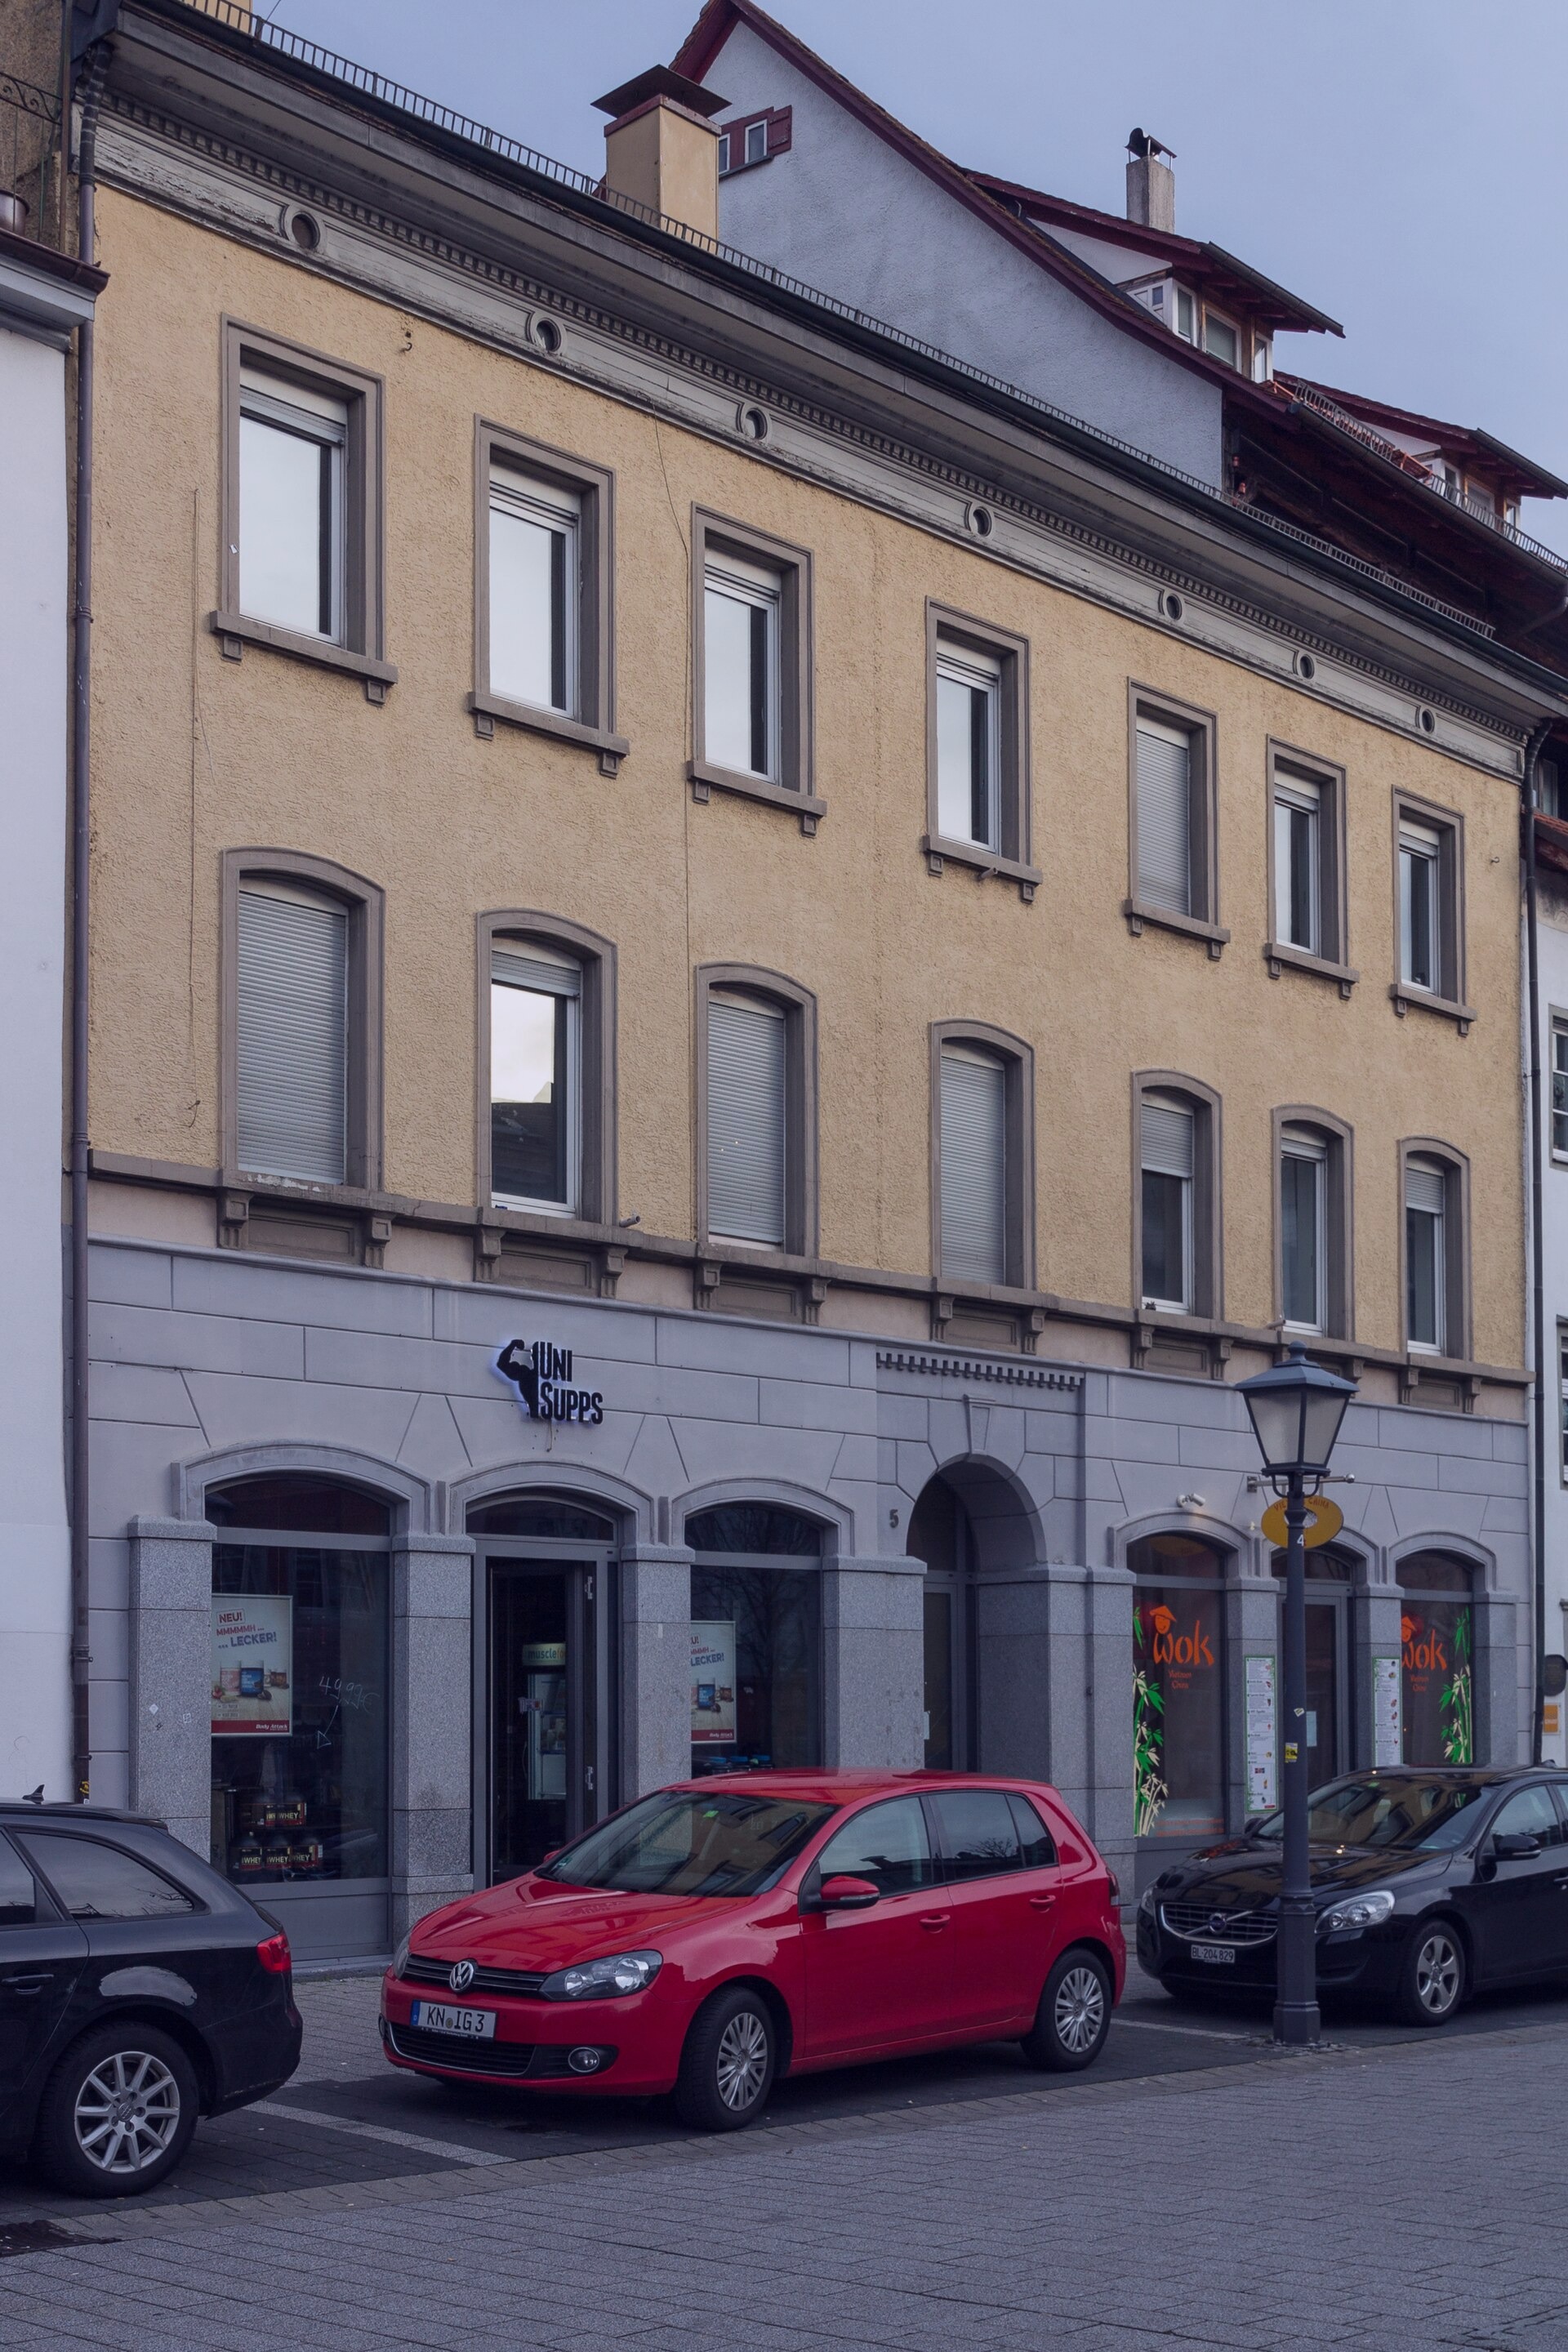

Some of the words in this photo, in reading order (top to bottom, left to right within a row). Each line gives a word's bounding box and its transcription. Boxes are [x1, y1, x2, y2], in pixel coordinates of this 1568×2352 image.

[539, 1341, 572, 1382] UNI
[540, 1382, 604, 1425] SUPPS
[889, 1508, 899, 1529] 5
[1296, 1534, 1304, 1547] 4
[219, 1611, 243, 1624] NEU!
[230, 1631, 278, 1648] LECKER!
[691, 1652, 725, 1667] LECKER!
[278, 1811, 298, 1820] WHEY
[269, 1855, 288, 1864] WHEY
[426, 2005, 446, 2028] KN
[454, 2010, 473, 2032] IG
[474, 2013, 485, 2034] 3
